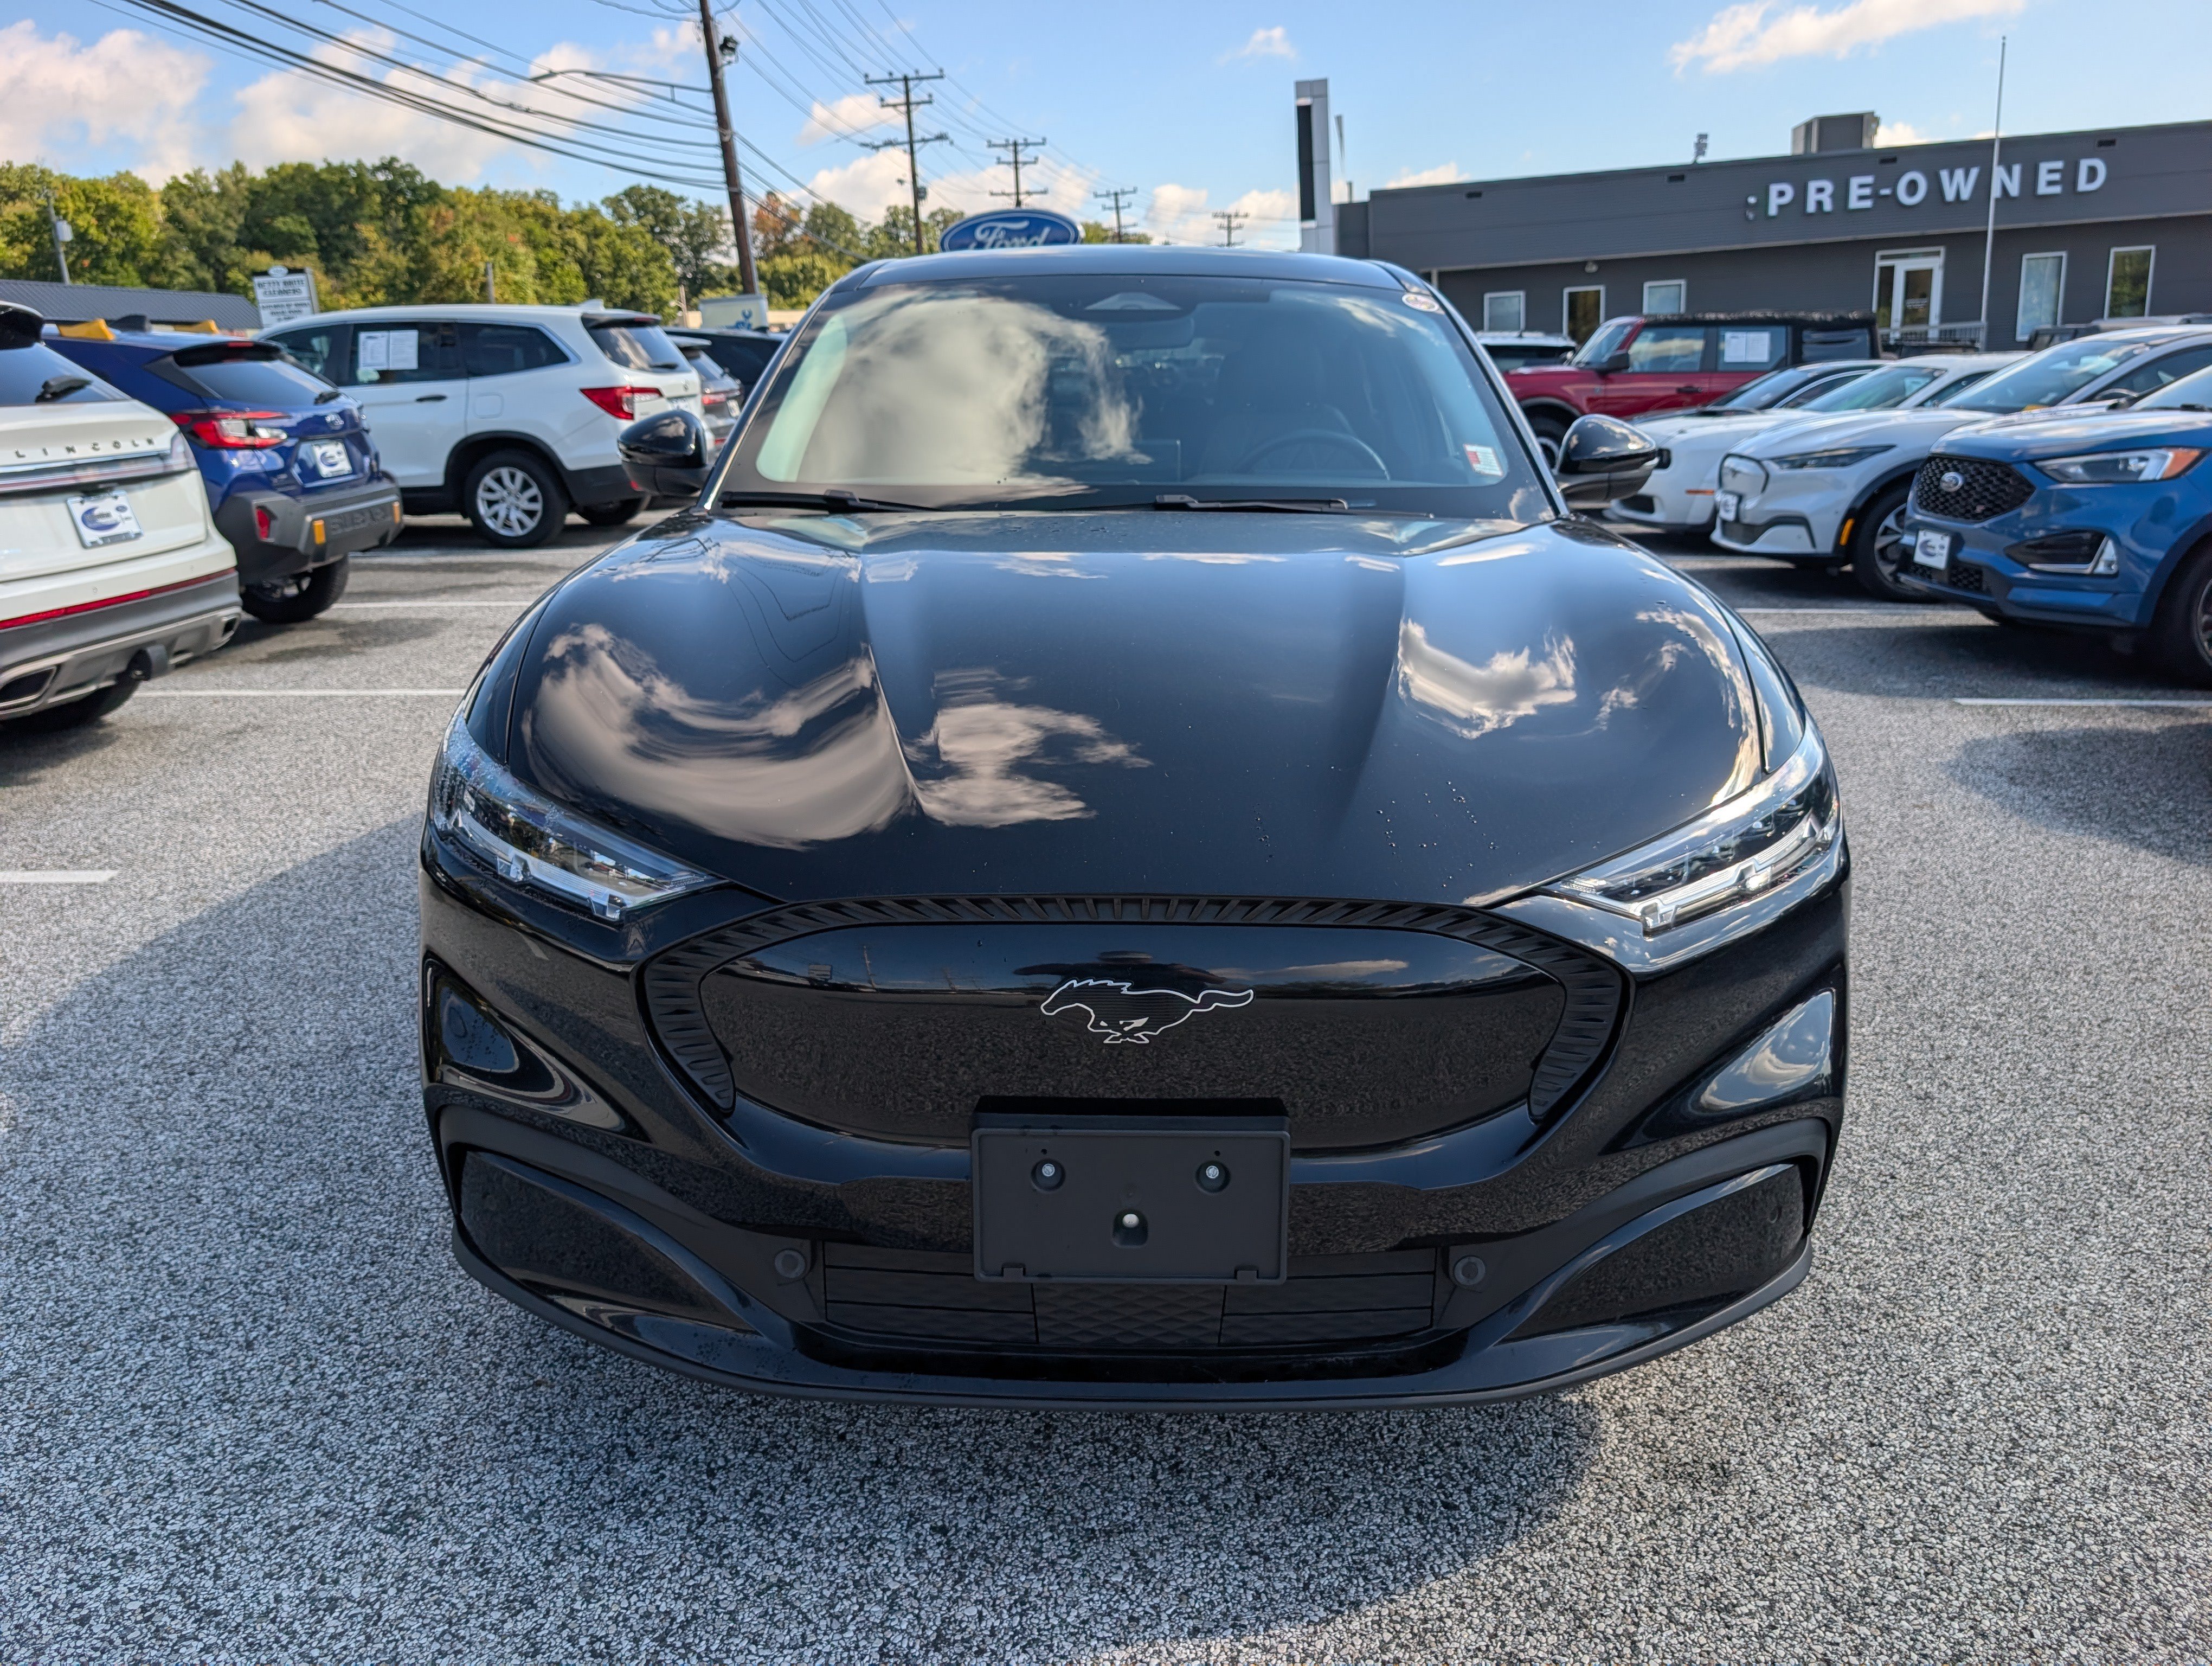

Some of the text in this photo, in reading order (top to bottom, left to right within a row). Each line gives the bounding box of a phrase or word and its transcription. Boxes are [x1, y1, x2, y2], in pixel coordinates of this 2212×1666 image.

[1767, 157, 2107, 217] PRE-OWNED
[969, 220, 1051, 250] Ford
[14, 437, 155, 458] LINCOLN
